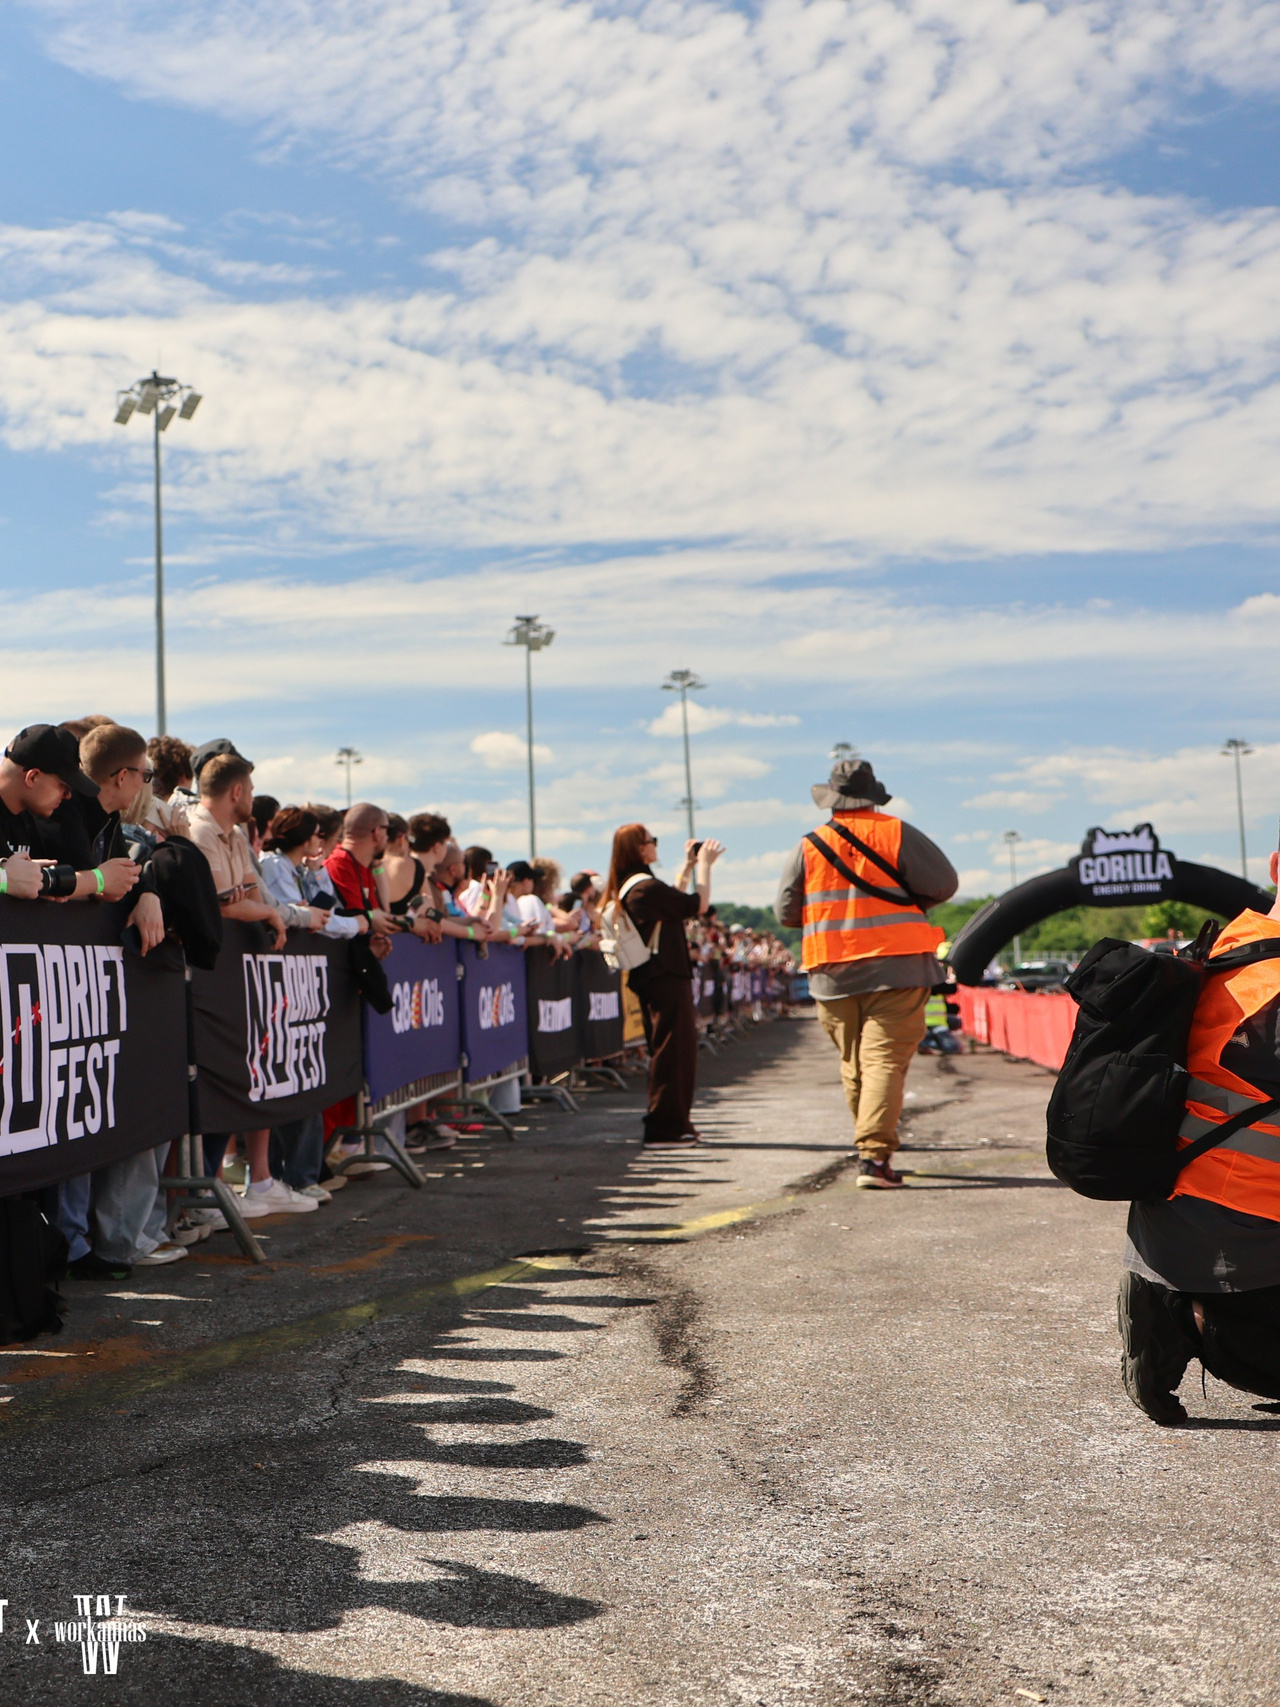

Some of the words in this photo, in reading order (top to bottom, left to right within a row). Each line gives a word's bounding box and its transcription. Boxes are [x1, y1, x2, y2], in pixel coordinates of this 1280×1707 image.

[1079, 851, 1173, 885] GORILLA
[1092, 884, 1130, 896] ENERGY
[1131, 882, 1161, 893] DRINK
[43, 944, 128, 1043] DRIFT
[286, 955, 331, 1023] DRIFT
[47, 1039, 120, 1146] FEST
[288, 1021, 327, 1094] FEST
